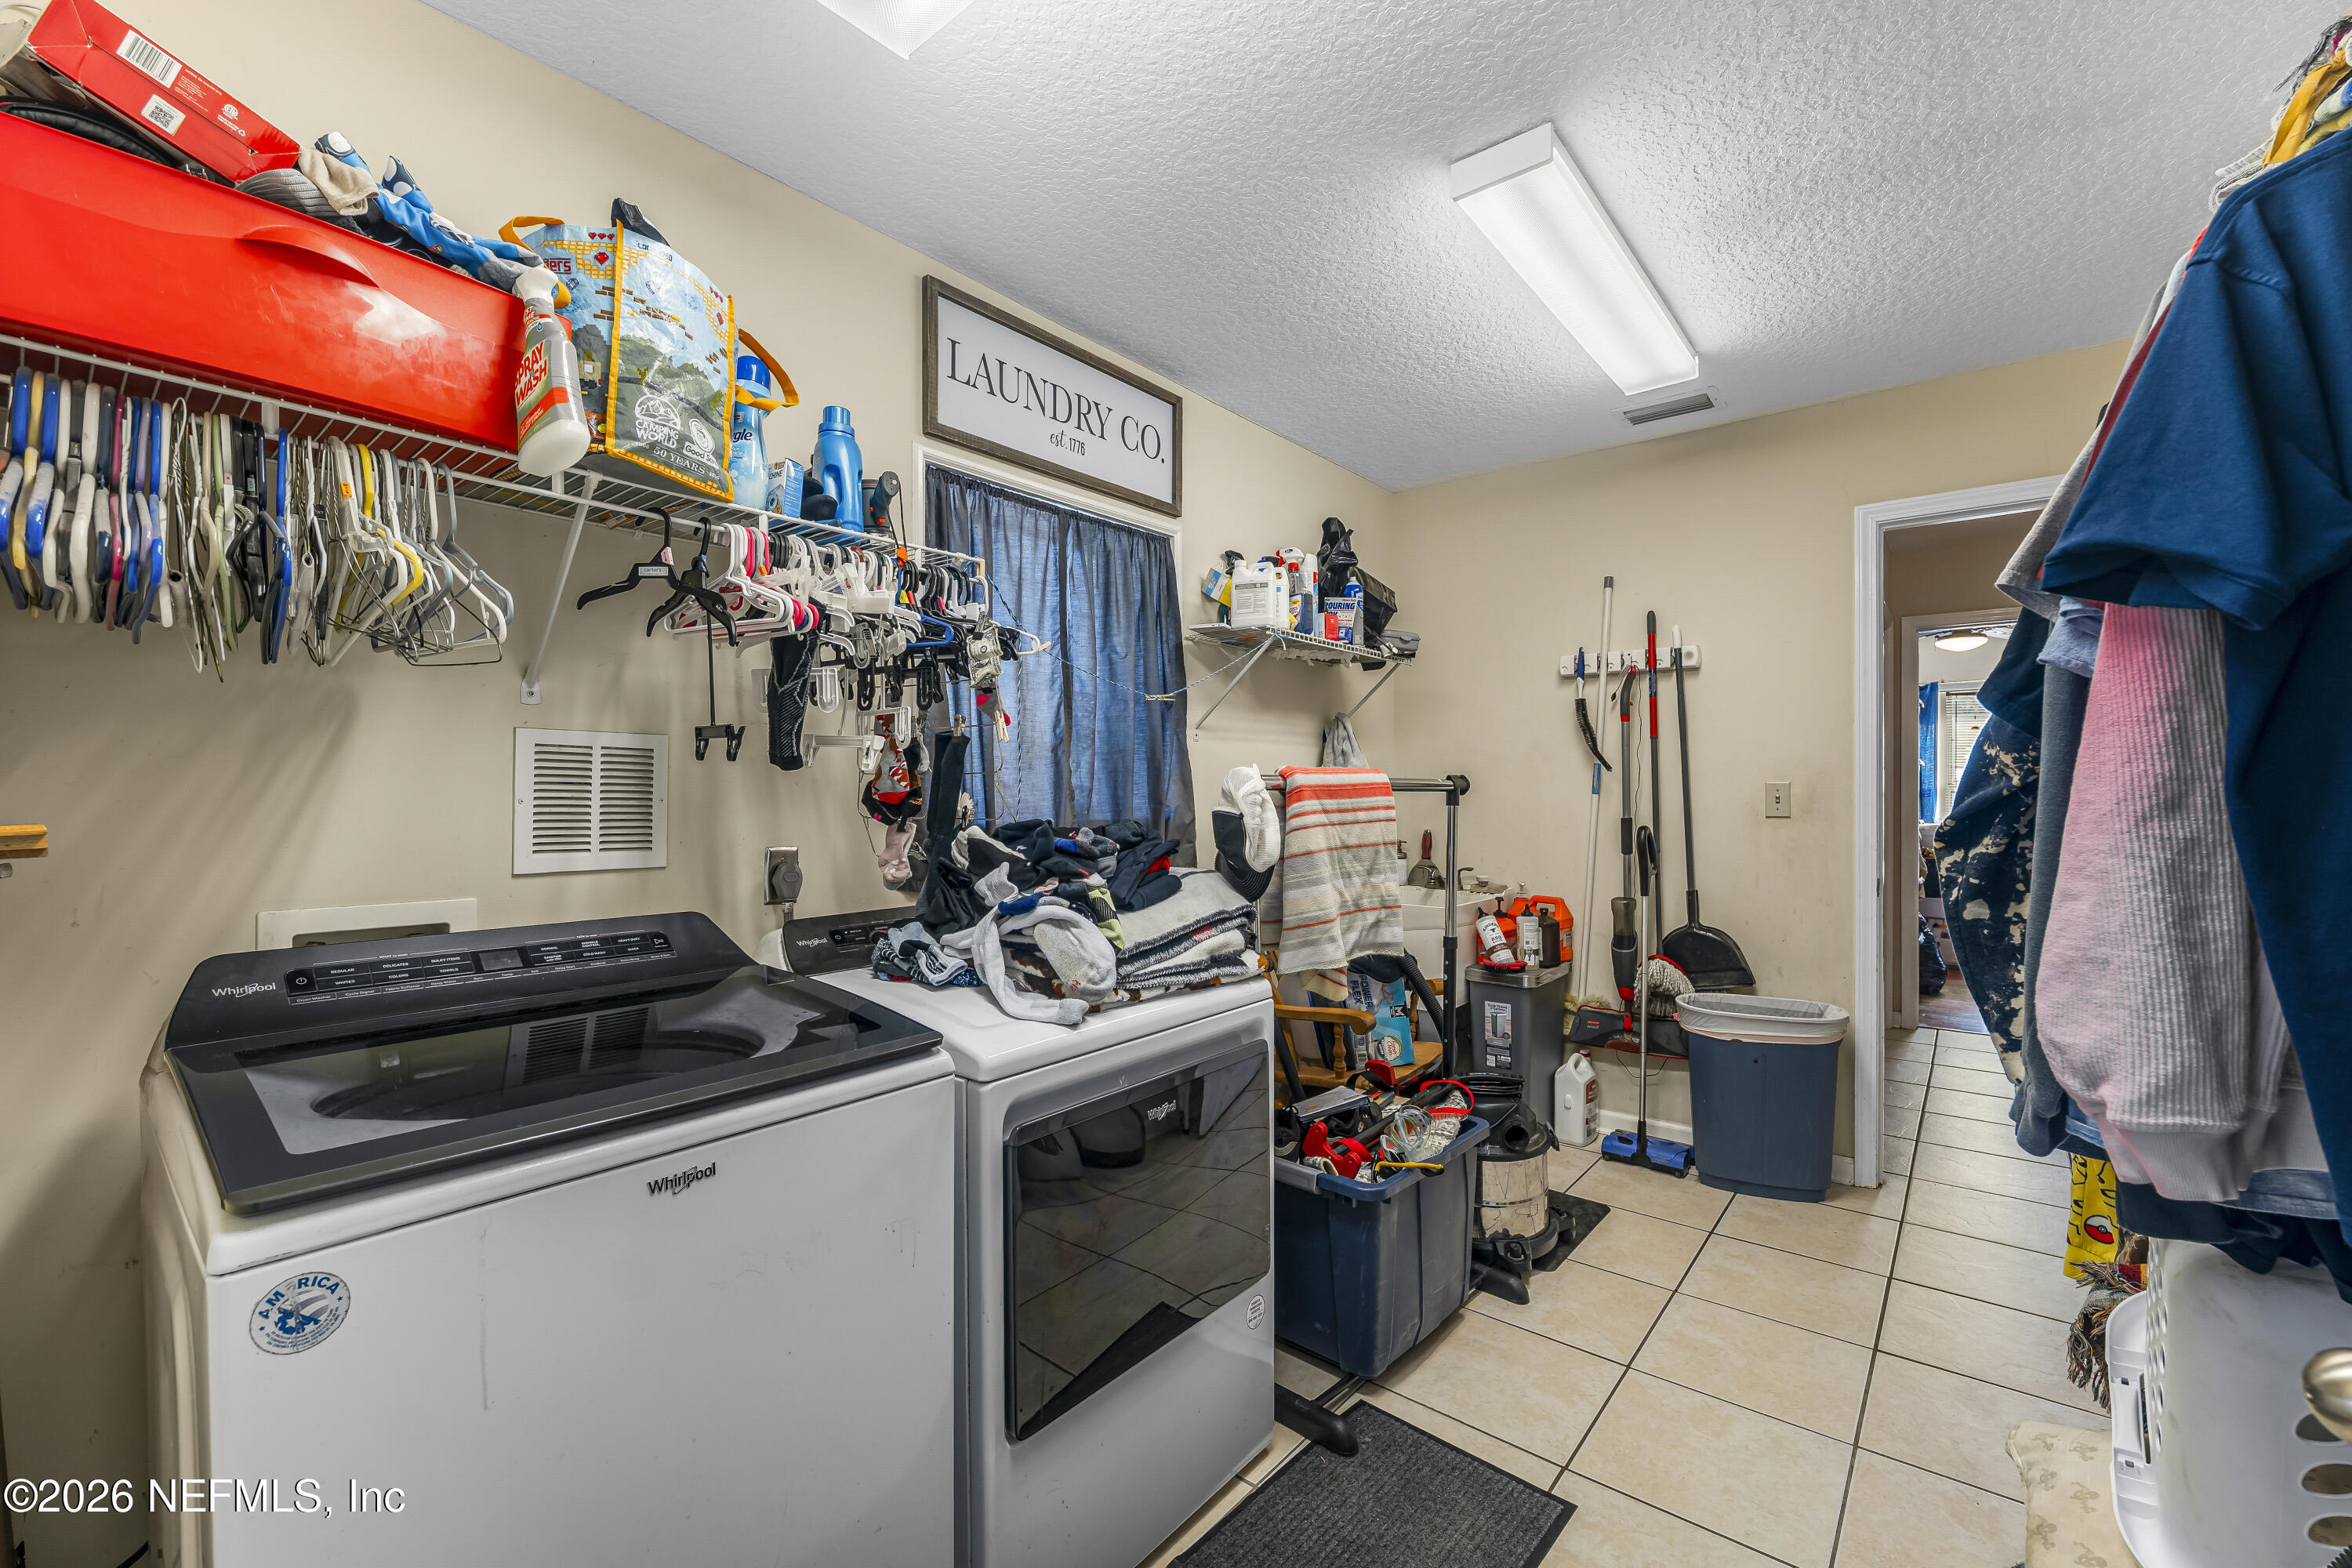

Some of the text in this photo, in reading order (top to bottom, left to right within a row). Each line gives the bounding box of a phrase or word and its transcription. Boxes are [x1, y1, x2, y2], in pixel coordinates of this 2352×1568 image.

[515, 358, 547, 407] WASH
[946, 336, 1165, 464] LAUNDRY CO.
[634, 419, 680, 440] CAMPING
[635, 426, 677, 449] WORLD
[733, 428, 753, 443] gle
[684, 445, 706, 459] Good
[1050, 430, 1086, 456] est. 1776
[653, 446, 706, 474] 50 YEARS
[768, 470, 783, 480] CHINE
[796, 937, 828, 948] Whirlpool
[211, 982, 276, 998] Whirlpool
[1349, 979, 1364, 1005] FLEX
[1358, 974, 1374, 1010] POWER
[1146, 1099, 1177, 1121] Whirlpool
[646, 1160, 717, 1195] Whirlpool
[257, 1275, 341, 1319] AMRICA
